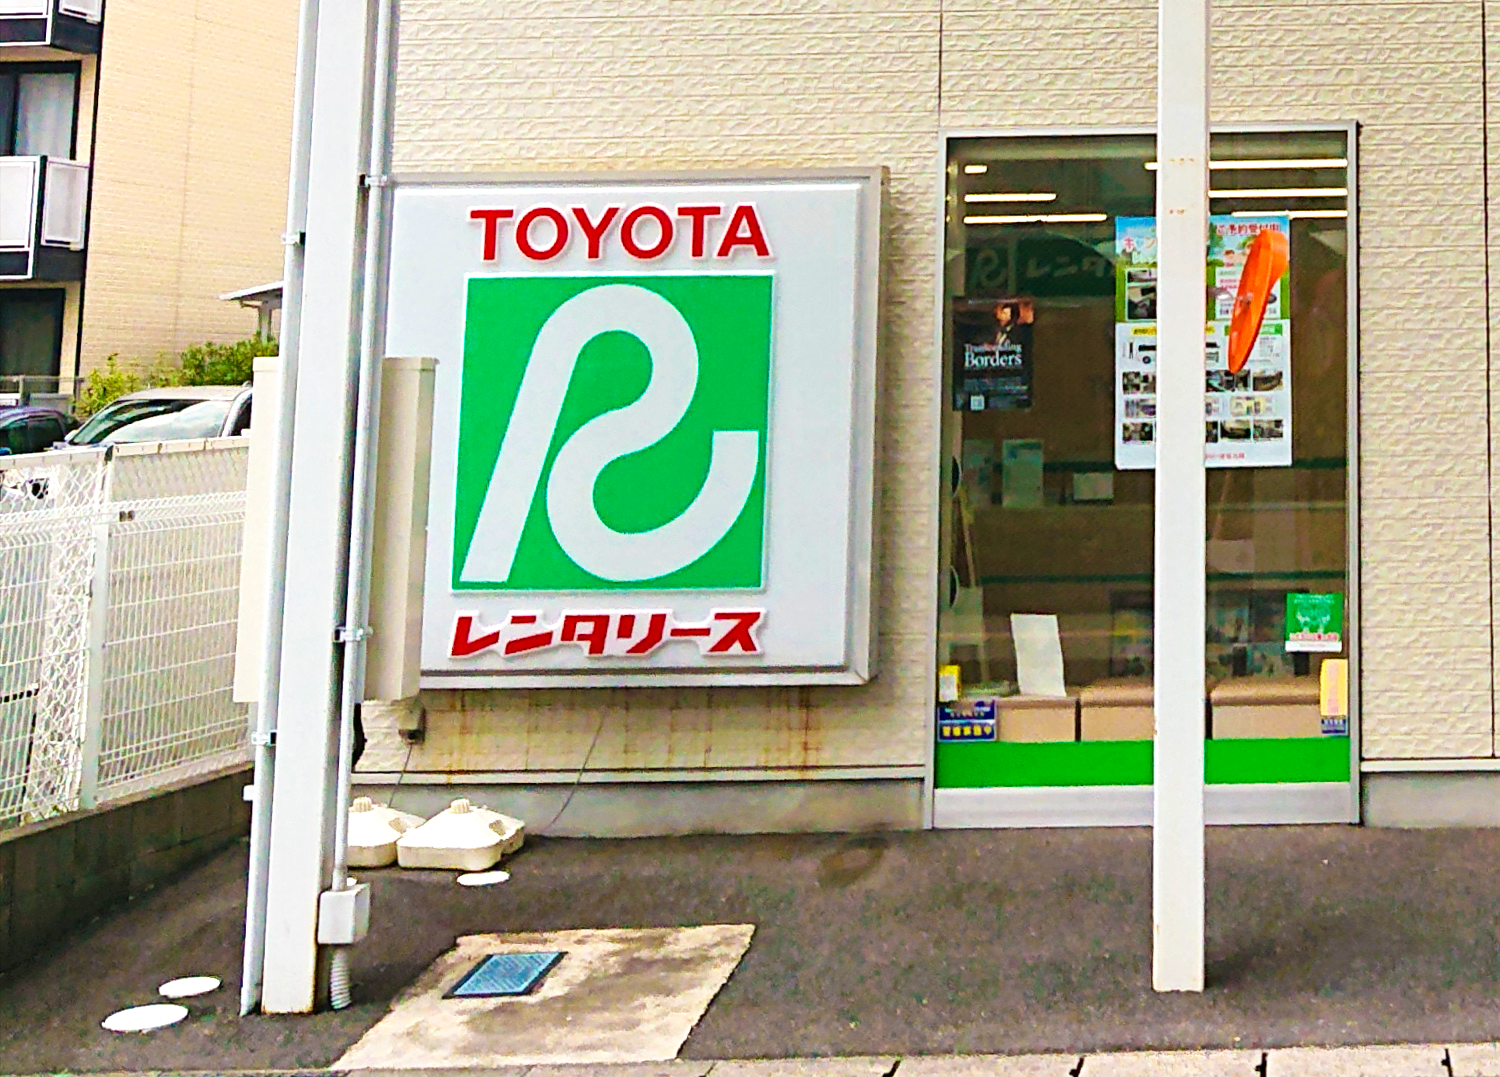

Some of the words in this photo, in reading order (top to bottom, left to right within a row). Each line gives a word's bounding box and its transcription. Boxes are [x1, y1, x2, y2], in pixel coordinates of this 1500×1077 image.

[468, 204, 771, 262] TOYOTA
[964, 350, 1022, 367] Borders
[451, 611, 761, 657] レンタリース
